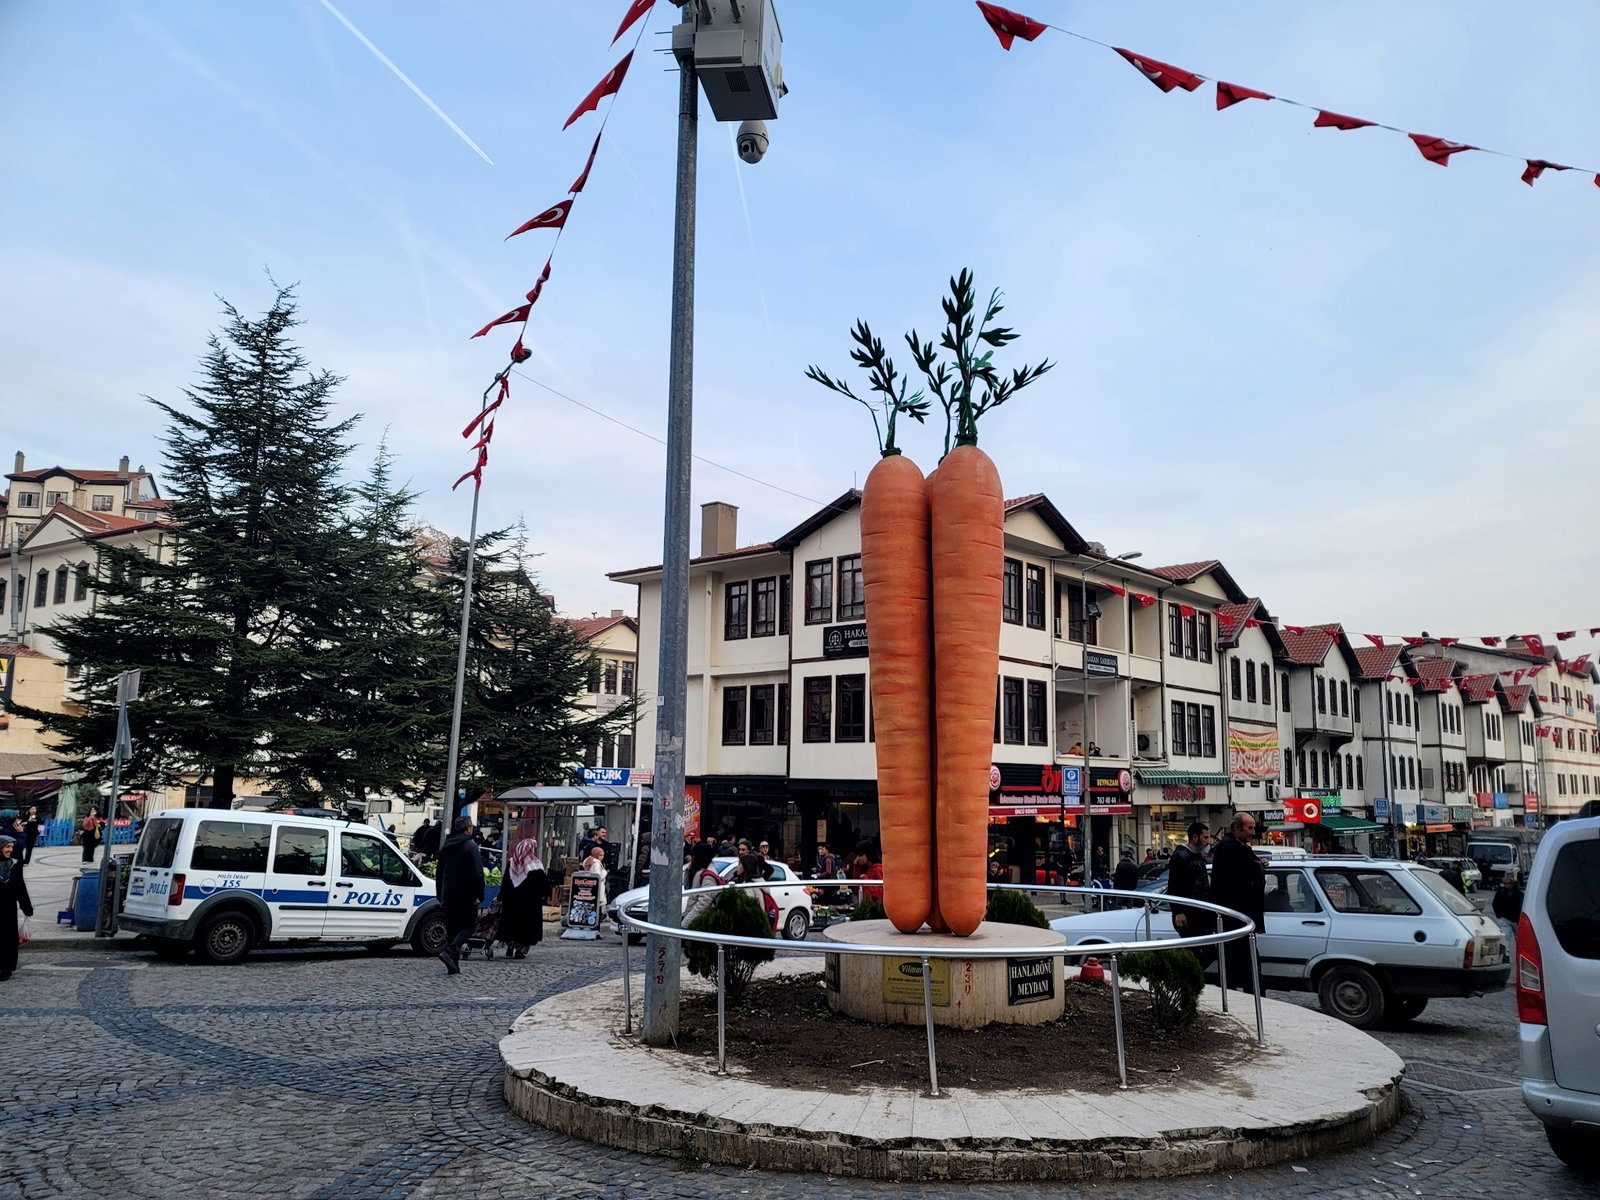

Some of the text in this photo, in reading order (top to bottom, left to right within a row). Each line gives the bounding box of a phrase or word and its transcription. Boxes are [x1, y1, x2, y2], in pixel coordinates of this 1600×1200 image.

[149, 881, 168, 895] POLİS
[222, 879, 241, 888] 155
[343, 889, 403, 906] POLİS
[1011, 959, 1053, 979] HANLARÖNÜ
[1017, 979, 1049, 996] MEYDANI
